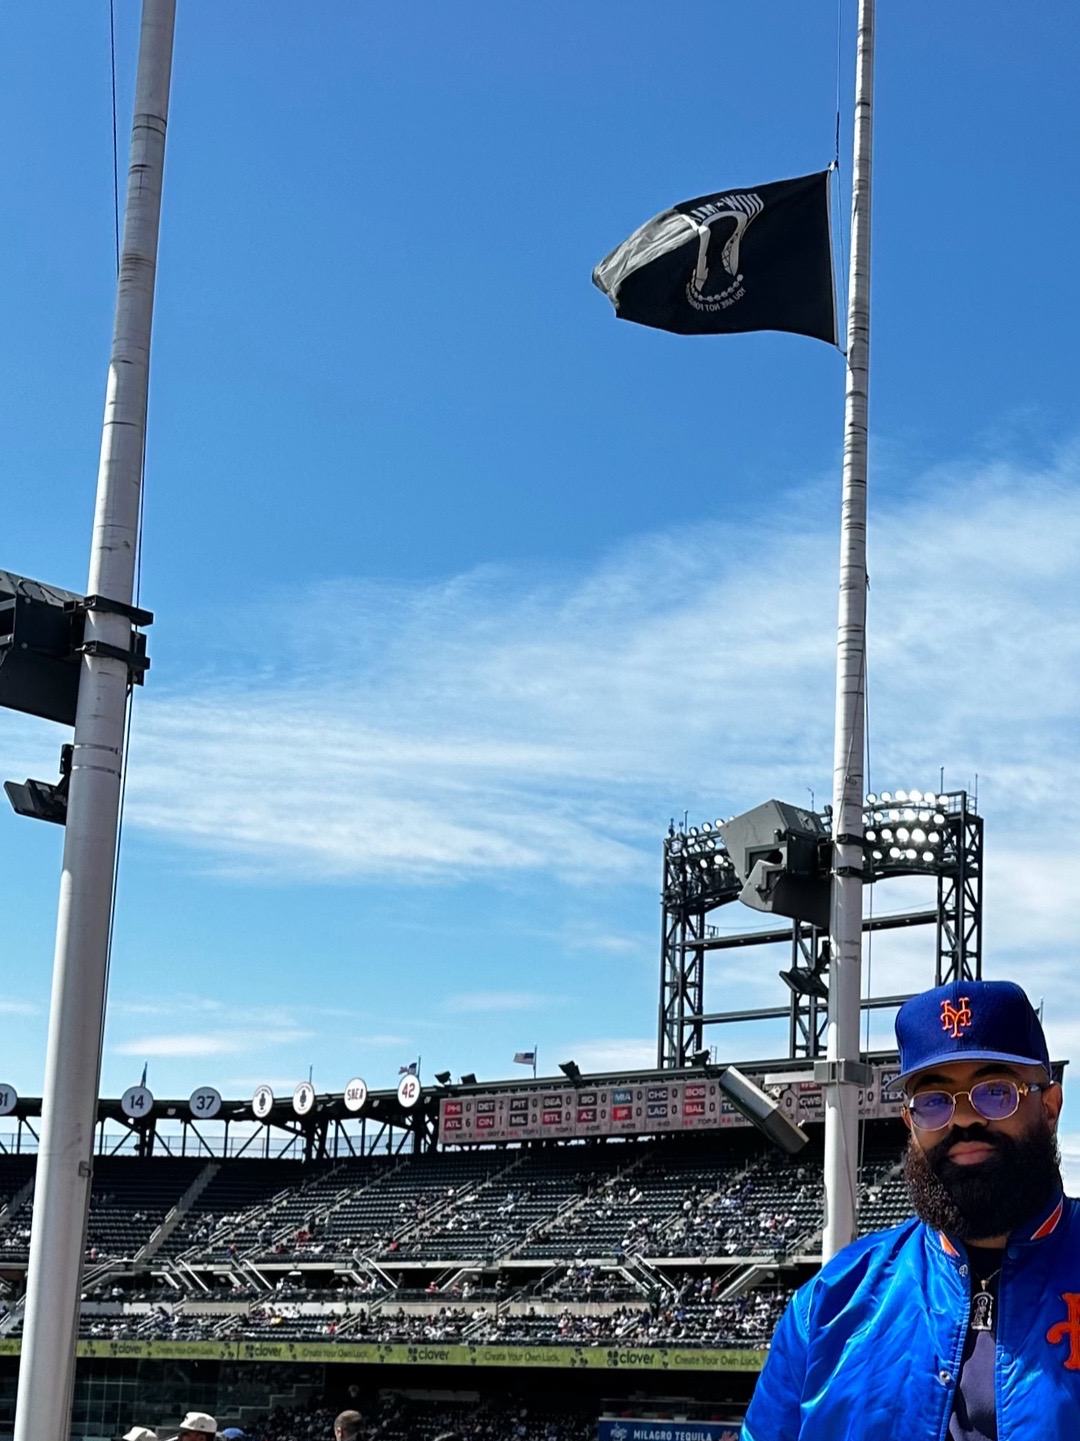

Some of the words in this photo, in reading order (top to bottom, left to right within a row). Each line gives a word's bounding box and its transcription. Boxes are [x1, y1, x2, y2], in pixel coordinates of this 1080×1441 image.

[347, 1088, 364, 1101] SHEA
[401, 1083, 415, 1099] 42
[637, 1091, 642, 1101] 0
[648, 1091, 667, 1099] CHC
[672, 1088, 678, 1098] 0
[685, 1087, 705, 1097] BOS
[710, 1085, 716, 1095] 0
[882, 1091, 902, 1100] TEX
[565, 1096, 571, 1105] 0
[600, 1093, 606, 1103] 0
[867, 1091, 874, 1102] 0
[130, 1095, 144, 1109] 14
[196, 1095, 215, 1110] 37
[465, 1102, 471, 1112] 0
[478, 1103, 494, 1111] DET
[512, 1100, 526, 1108] PIT
[532, 1098, 538, 1108] 0
[636, 1107, 642, 1117] 0
[648, 1107, 667, 1115] LAD
[671, 1105, 677, 1114] 0
[685, 1105, 704, 1113] BAL
[709, 1102, 715, 1112] 0
[531, 1113, 537, 1123] 0
[544, 1114, 560, 1122] STL
[565, 1112, 571, 1121] 0
[581, 1112, 593, 1120] AZ
[600, 1109, 606, 1119] 0
[446, 1120, 460, 1128] ATL
[465, 1118, 471, 1127] 6
[478, 1118, 493, 1126] CIN
[254, 1345, 283, 1357] clover
[418, 1348, 449, 1360] clover
[484, 1351, 506, 1361] Create
[619, 1350, 655, 1365] clover
[675, 1355, 698, 1365] Create
[699, 1355, 719, 1366] Your
[720, 1355, 739, 1366] Own
[633, 1429, 673, 1441] MILAGRO
[675, 1431, 712, 1441] TEQUILA
